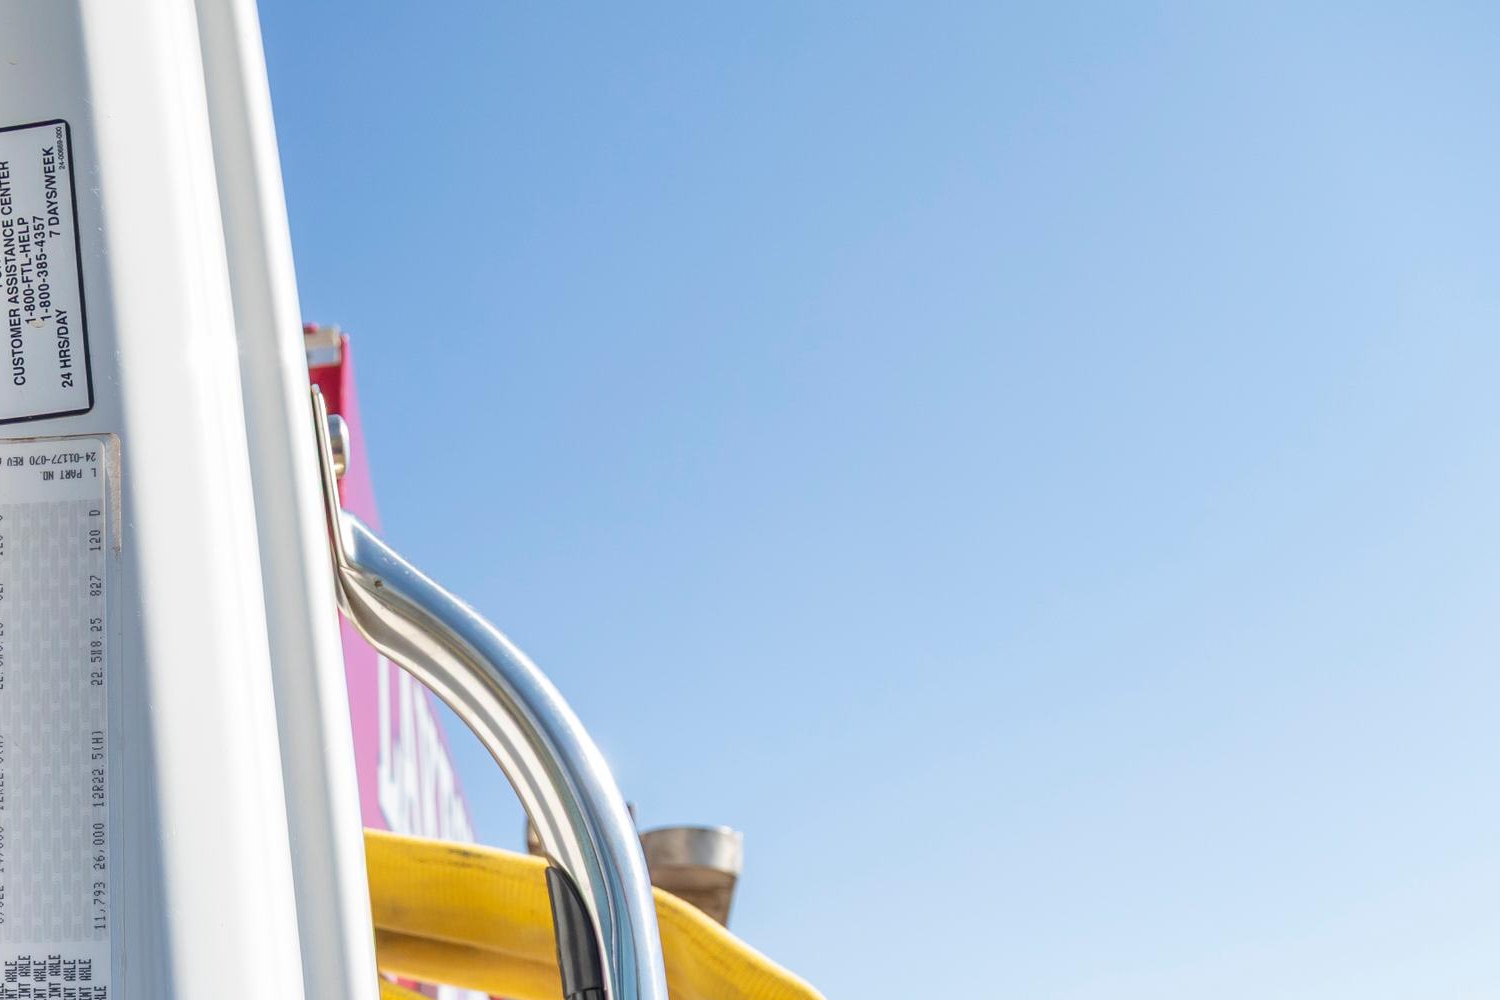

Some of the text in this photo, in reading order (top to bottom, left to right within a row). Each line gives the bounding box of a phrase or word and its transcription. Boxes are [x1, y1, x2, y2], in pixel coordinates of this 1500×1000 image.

[42, 146, 60, 226] DAYS/WEEK
[1, 219, 19, 304] ASSISTANCE
[17, 217, 36, 324] 1-800-FTL-HELP
[33, 215, 52, 321] 1-800-385-4357
[8, 308, 25, 386] CUSTOMER
[55, 309, 73, 388] 24 HRS/DAY
[6, 455, 23, 465] REV
[59, 469, 82, 478] PART
[90, 468, 96, 477] L
[89, 509, 100, 517] D
[89, 530, 101, 552] 120
[90, 575, 102, 596] 827
[94, 822, 106, 870] 26,000
[94, 882, 106, 930] 11,793
[5, 960, 18, 982] AXLE
[18, 955, 31, 977] AXLE
[34, 960, 46, 982] AXLE
[48, 954, 62, 976] AXLE
[64, 960, 76, 982] AXLE
[79, 959, 92, 981] AXLE
[18, 983, 31, 999] INT
[48, 982, 62, 998] INT
